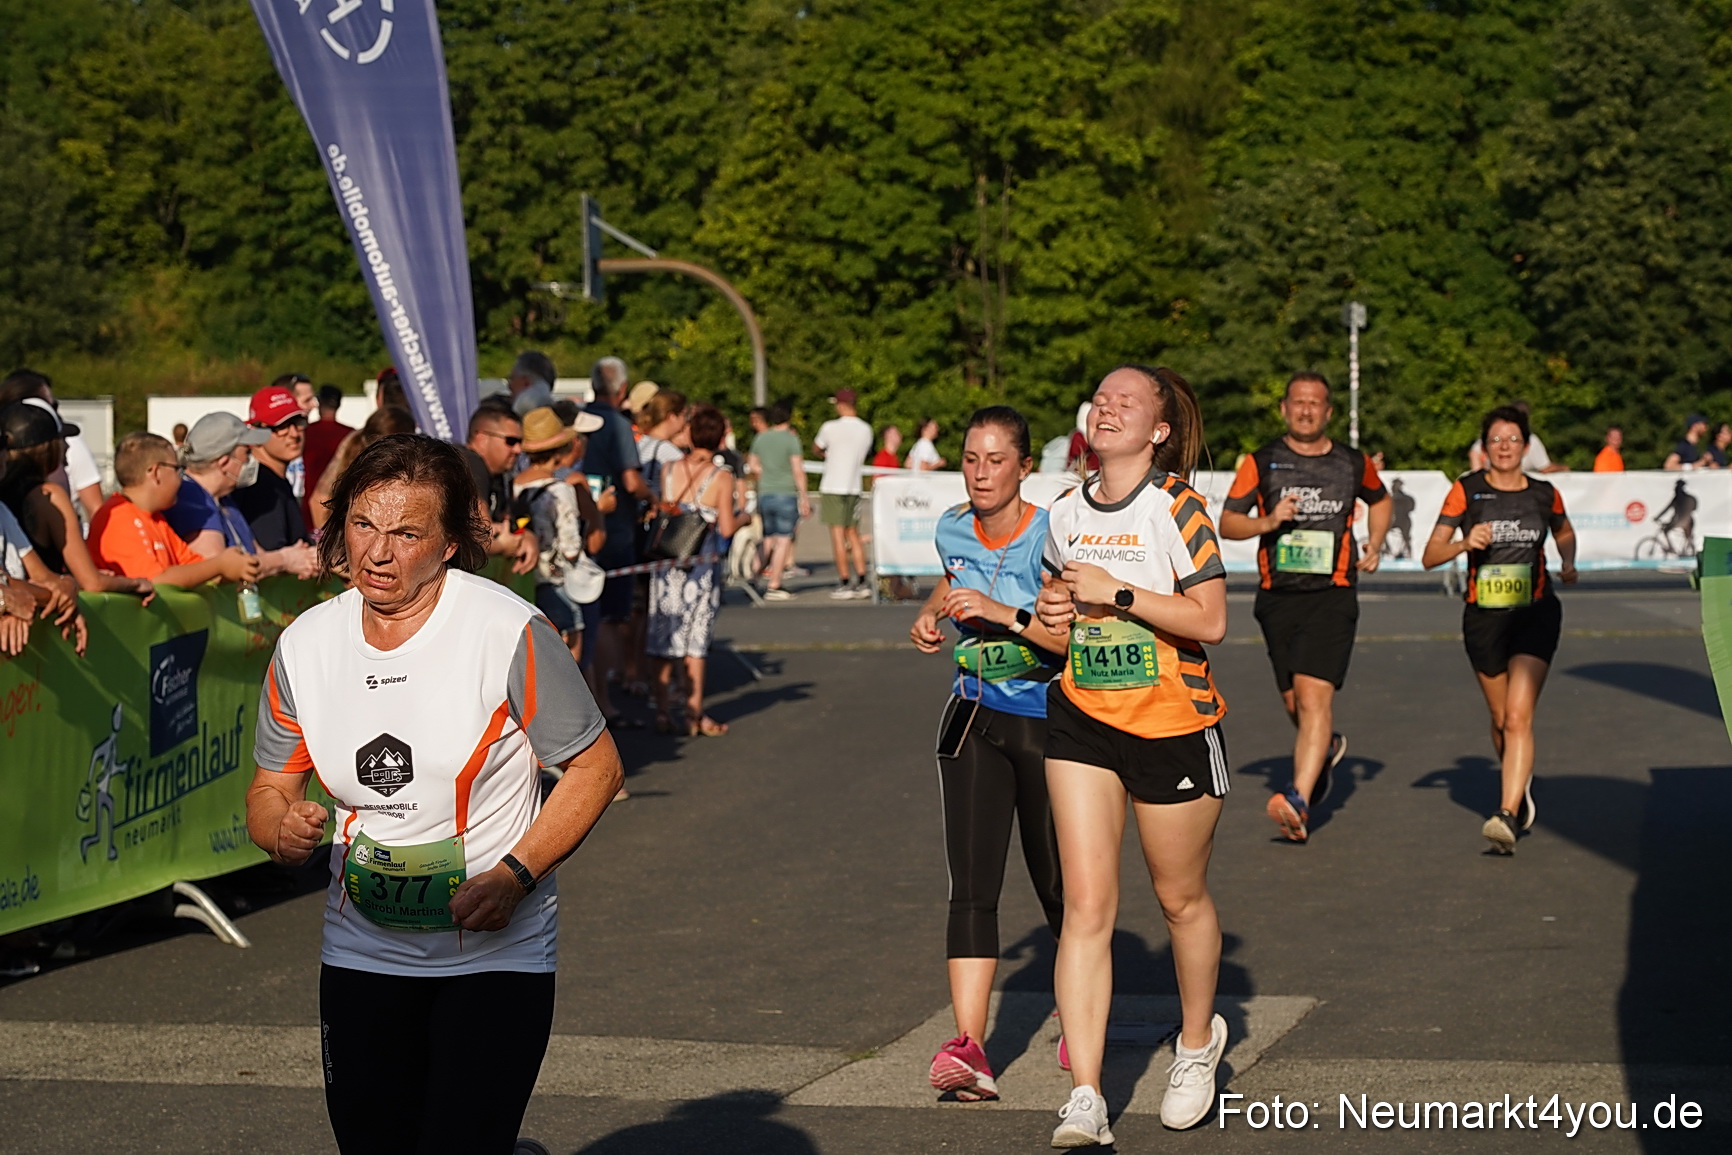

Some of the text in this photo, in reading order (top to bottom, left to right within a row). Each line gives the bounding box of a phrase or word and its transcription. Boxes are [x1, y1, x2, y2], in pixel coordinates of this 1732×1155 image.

[1484, 520, 1522, 533] ECK
[1080, 533, 1145, 547] KLEBL
[1075, 548, 1146, 562] DYNAMICS
[1288, 545, 1323, 559] 1741
[1486, 580, 1523, 594] 1990
[981, 645, 1008, 666] 12
[1074, 651, 1083, 676] RUN
[1081, 643, 1142, 668] 1418
[1142, 645, 1155, 677] 2022
[380, 674, 408, 686] spized
[1091, 668, 1135, 677] Nutz Maria
[124, 704, 245, 822] firmenlauf
[125, 802, 182, 850] neumarkt
[368, 857, 406, 869] Firmenlauf
[350, 873, 360, 904] RUN
[369, 871, 433, 904] 377
[364, 899, 445, 917] Strobl Martina
